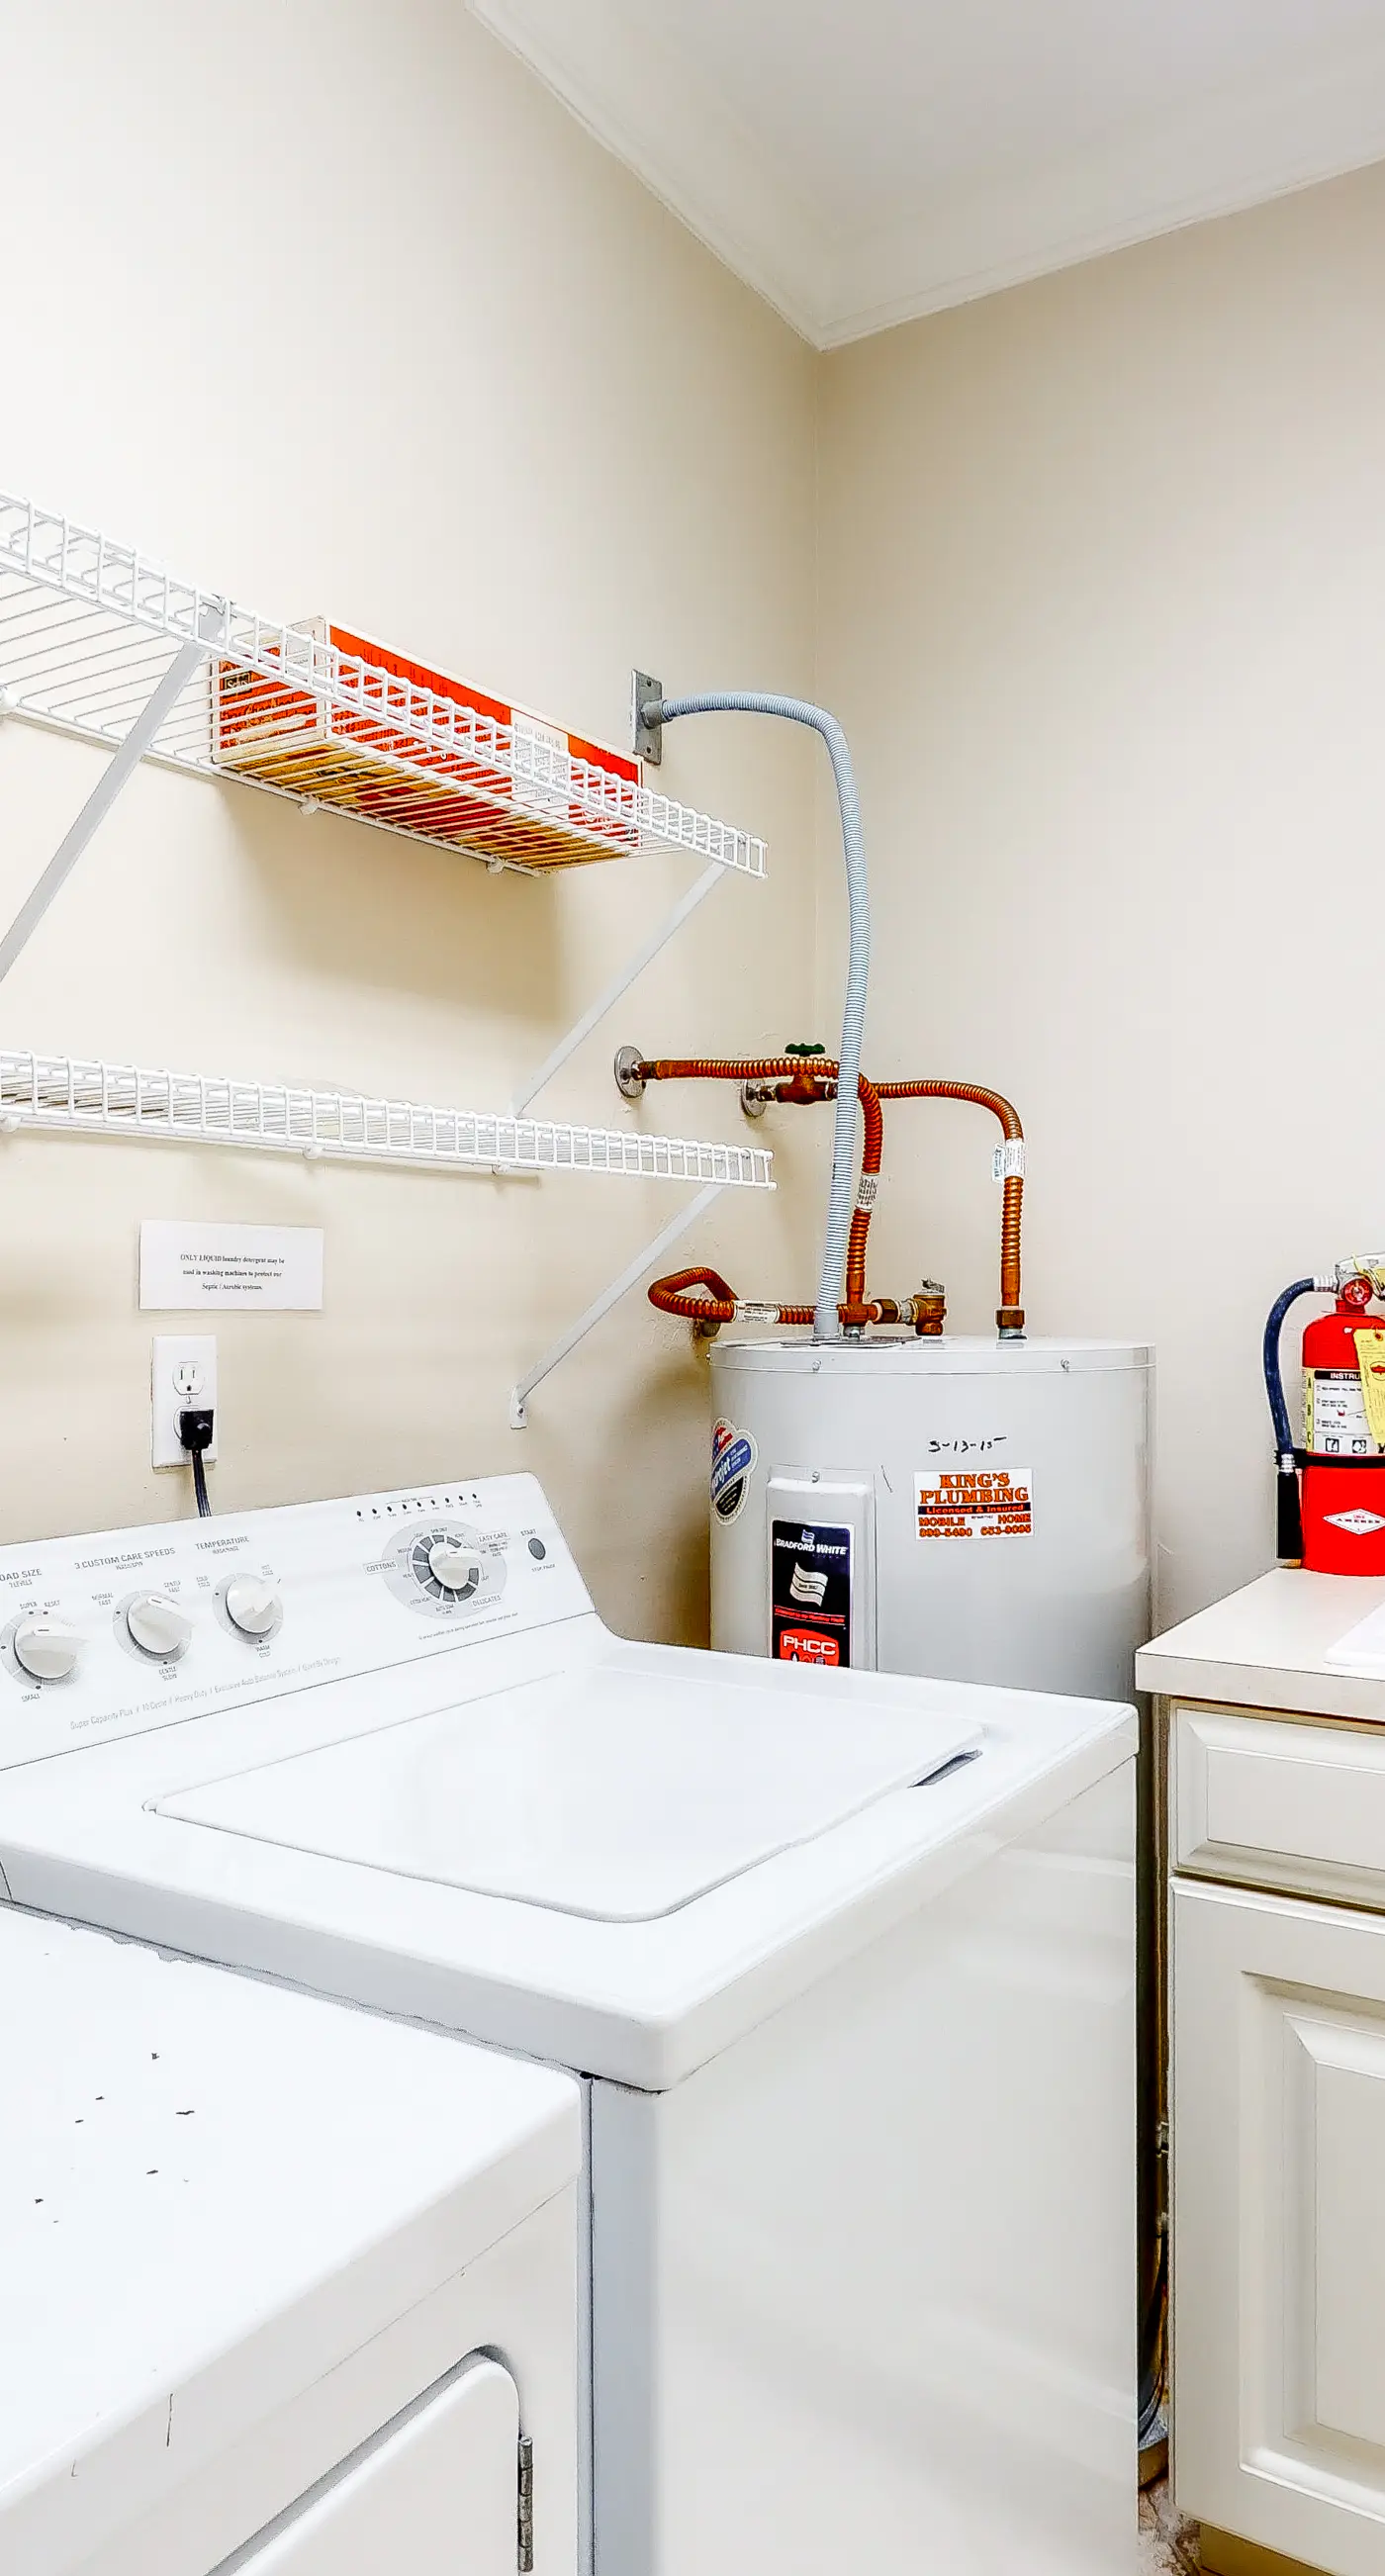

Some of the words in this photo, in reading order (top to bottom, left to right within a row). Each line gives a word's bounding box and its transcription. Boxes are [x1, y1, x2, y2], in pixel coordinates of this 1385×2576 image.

[939, 1472, 1010, 1489] KING'S
[920, 1487, 1029, 1505] PLUMBING
[926, 1506, 973, 1515] Licensed
[987, 1504, 1024, 1513] Insured
[918, 1517, 966, 1526] MOBILE
[997, 1513, 1032, 1524] HOME
[195, 1535, 249, 1550] TEMPERATURE
[776, 1538, 815, 1552] BRADFORD
[816, 1543, 848, 1555] WHITE
[81, 1556, 120, 1569] CUSTOM
[121, 1552, 143, 1563] CARE
[144, 1547, 176, 1559] SPEEDS
[22, 1568, 43, 1579] SIZE
[366, 1561, 397, 1573] COTTONS
[473, 1595, 501, 1607] DELICATES
[784, 1635, 836, 1656] PHCC
[70, 1719, 89, 1729] Super
[91, 1712, 119, 1725] Capacity
[119, 1708, 134, 1718] Plus
[150, 1700, 167, 1710] Cycle
[174, 1693, 193, 1703] Heavy
[194, 1689, 208, 1699] Duty
[215, 1682, 240, 1694] Exclusive
[255, 1672, 276, 1683] Balance
[277, 1669, 298, 1681] System
